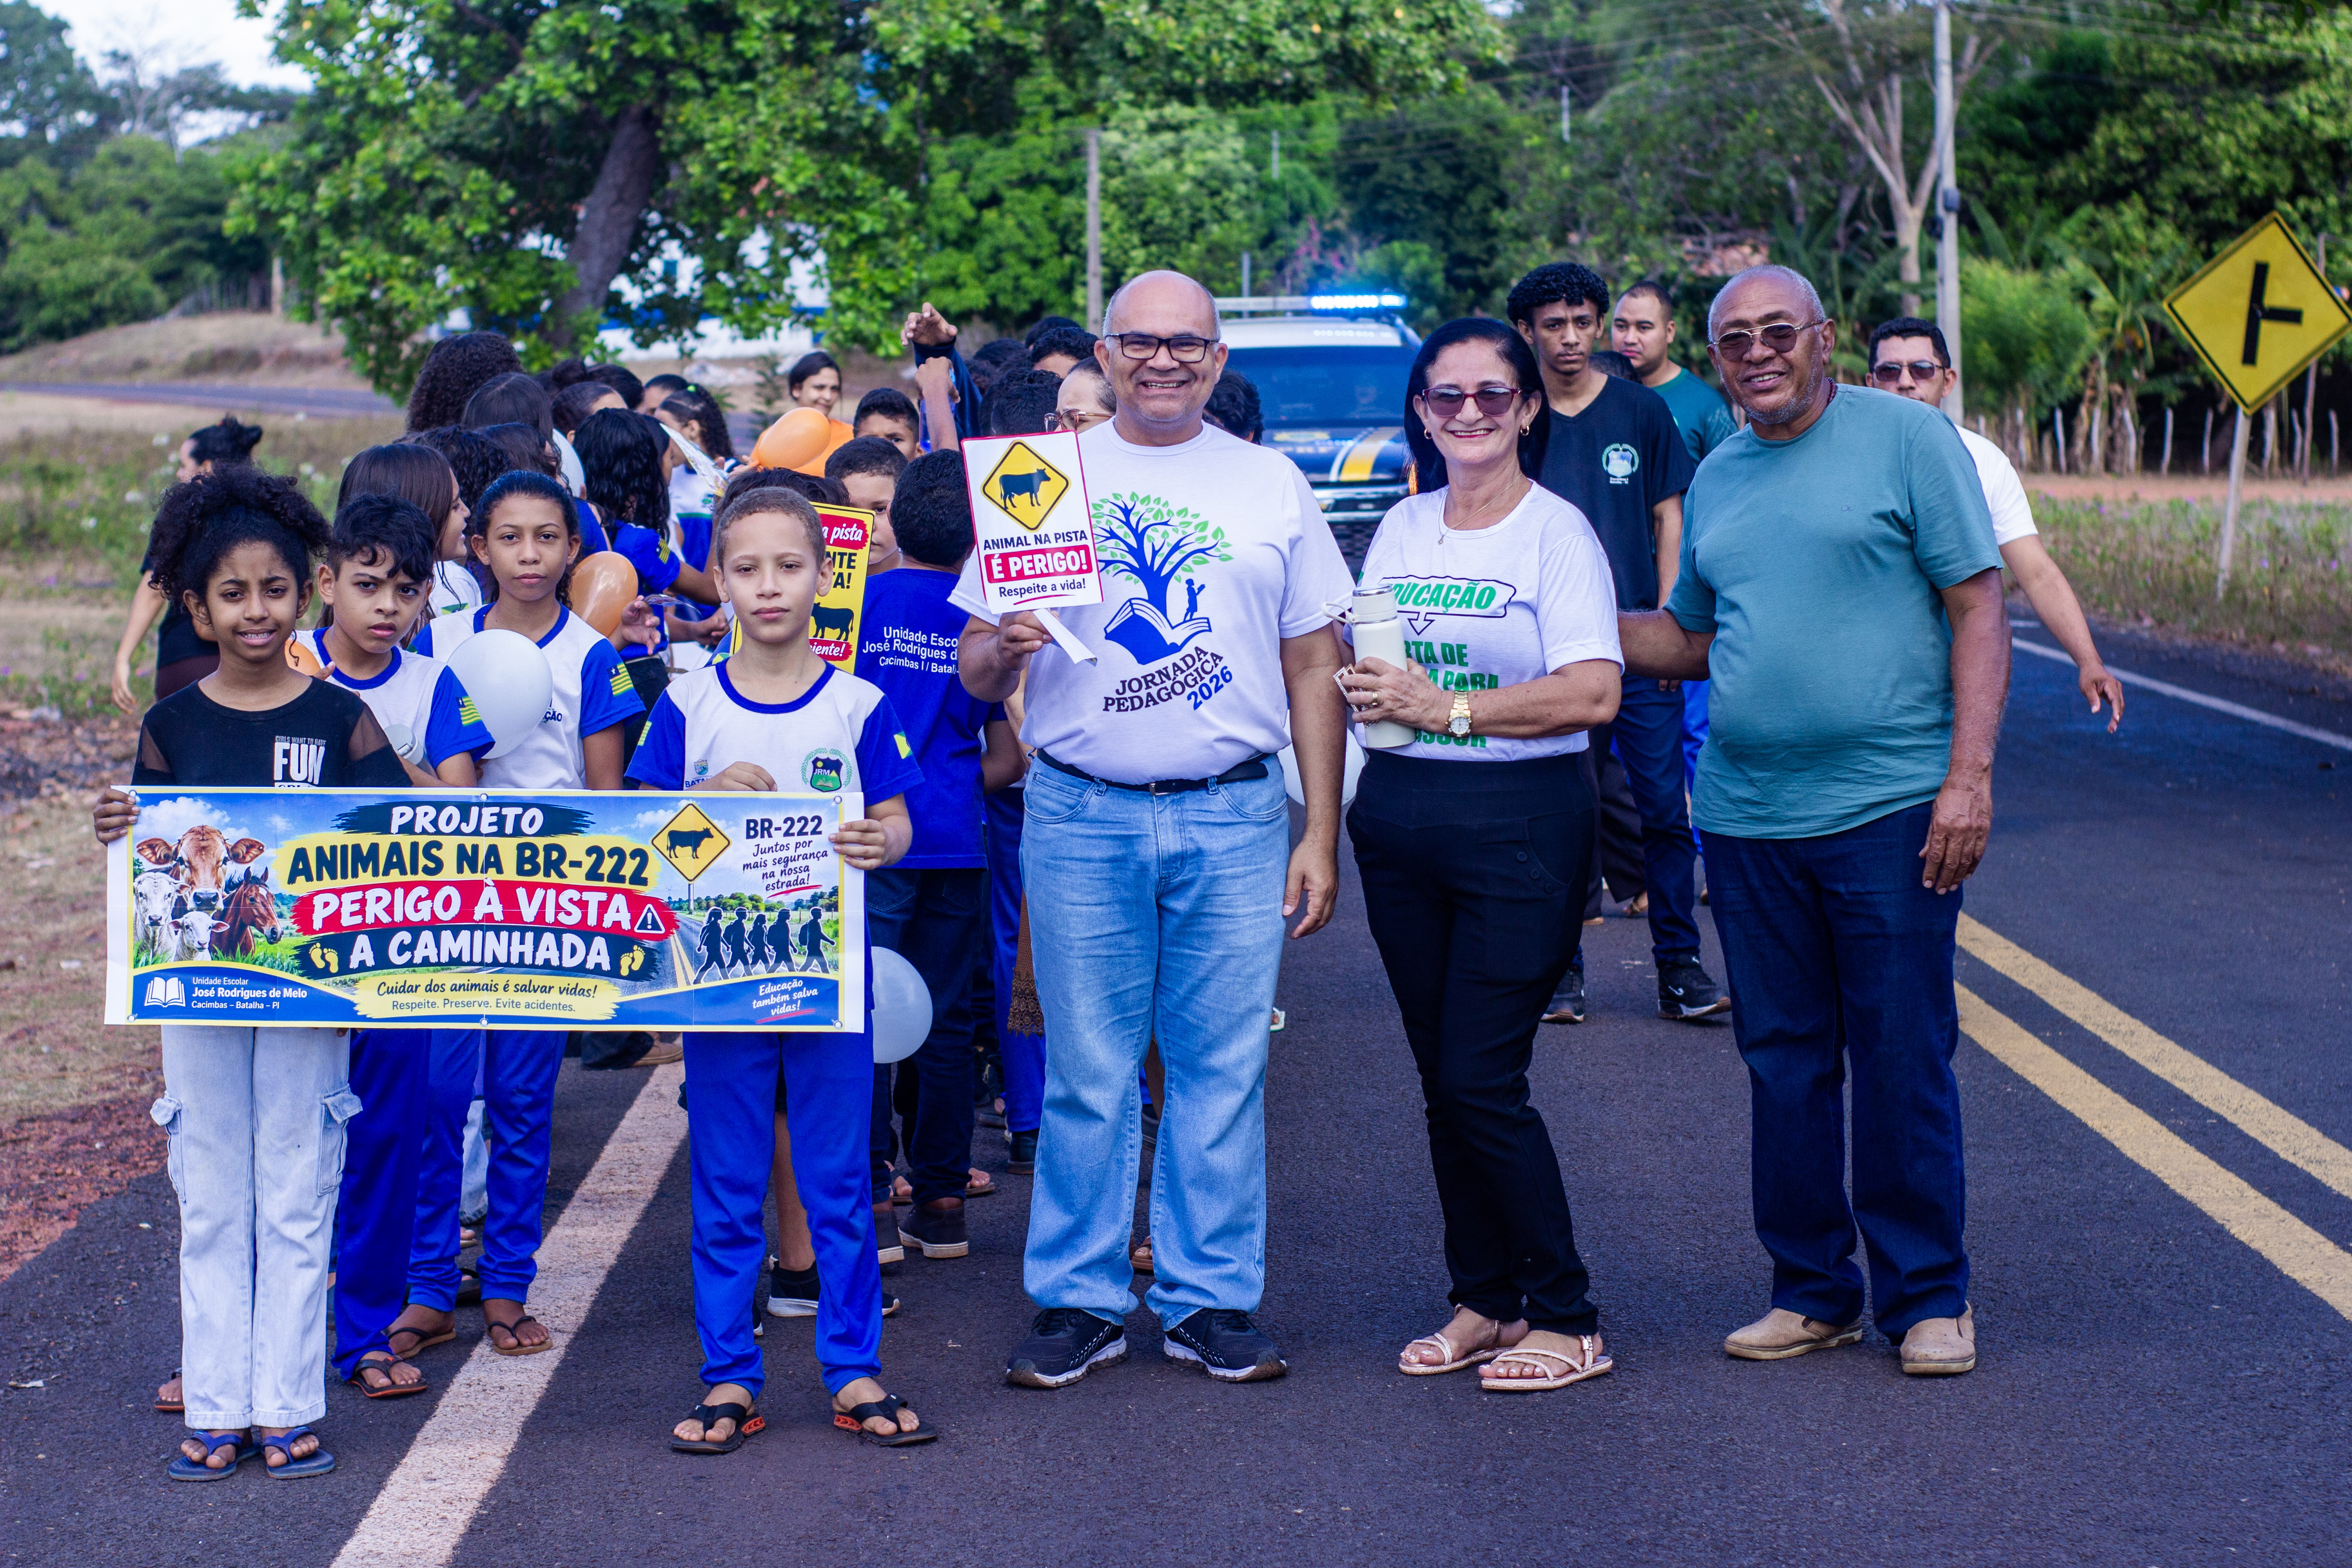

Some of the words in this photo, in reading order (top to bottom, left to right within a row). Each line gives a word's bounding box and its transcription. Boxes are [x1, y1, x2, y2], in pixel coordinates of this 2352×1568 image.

[830, 523, 863, 544] pista
[984, 535, 1031, 550] ANIMAL
[1034, 534, 1052, 545] NA
[1054, 530, 1088, 544] PISTA
[991, 554, 1004, 579] É
[1009, 549, 1088, 578] PERIGO!
[833, 572, 852, 589] A!
[999, 583, 1047, 598] Respeite
[1060, 578, 1086, 590] vida!
[1387, 582, 1496, 613] DUCAÇÃO
[884, 627, 927, 643] Unidade
[931, 633, 958, 647] Esco
[810, 642, 846, 657] iente!
[862, 639, 890, 653] José
[893, 639, 946, 659] Rodrigues
[951, 649, 957, 660] d
[1441, 642, 1469, 667] DE
[879, 656, 919, 669] Cacimbas
[926, 662, 929, 671] /
[1115, 646, 1208, 696] JORNADA
[1102, 652, 1223, 713] PEDAGÓGICA
[1186, 666, 1233, 710] 2026
[1443, 670, 1499, 691] PARA
[543, 710, 562, 722] ÇÃO
[274, 742, 325, 785] FUN
[391, 806, 544, 834] PROJETO
[746, 815, 823, 839] BR-222
[753, 842, 790, 857] Juntos
[795, 840, 813, 853] por
[287, 840, 444, 885] ANIMAIS
[456, 843, 504, 875] NA
[516, 842, 649, 886] BR-222
[743, 858, 767, 871] mais
[772, 850, 828, 868] segurança
[762, 871, 775, 879] na
[780, 865, 810, 877] nossa
[765, 873, 810, 892] estrada!
[313, 885, 461, 931] PERIGO
[473, 877, 504, 922] À
[516, 887, 631, 931] VISTA
[349, 934, 375, 969] A
[389, 930, 610, 971] CAMINHADA
[192, 987, 215, 997] José
[218, 988, 267, 1000] Rodrigues
[269, 988, 281, 998] de
[283, 988, 307, 998] Melo
[377, 982, 421, 996] Cuidar
[425, 980, 446, 994] dos
[450, 980, 499, 993] animais
[503, 980, 510, 992] é
[514, 980, 554, 994] salvar
[559, 982, 598, 998] vidas!
[760, 979, 803, 995] Educação
[392, 999, 439, 1012] Respeite.
[443, 999, 492, 1009] Preserve.
[496, 998, 521, 1008] Evite
[524, 999, 576, 1012] acidentes.
[752, 993, 790, 1009] também
[793, 987, 818, 1000] salva
[771, 1000, 800, 1016] vidas!
